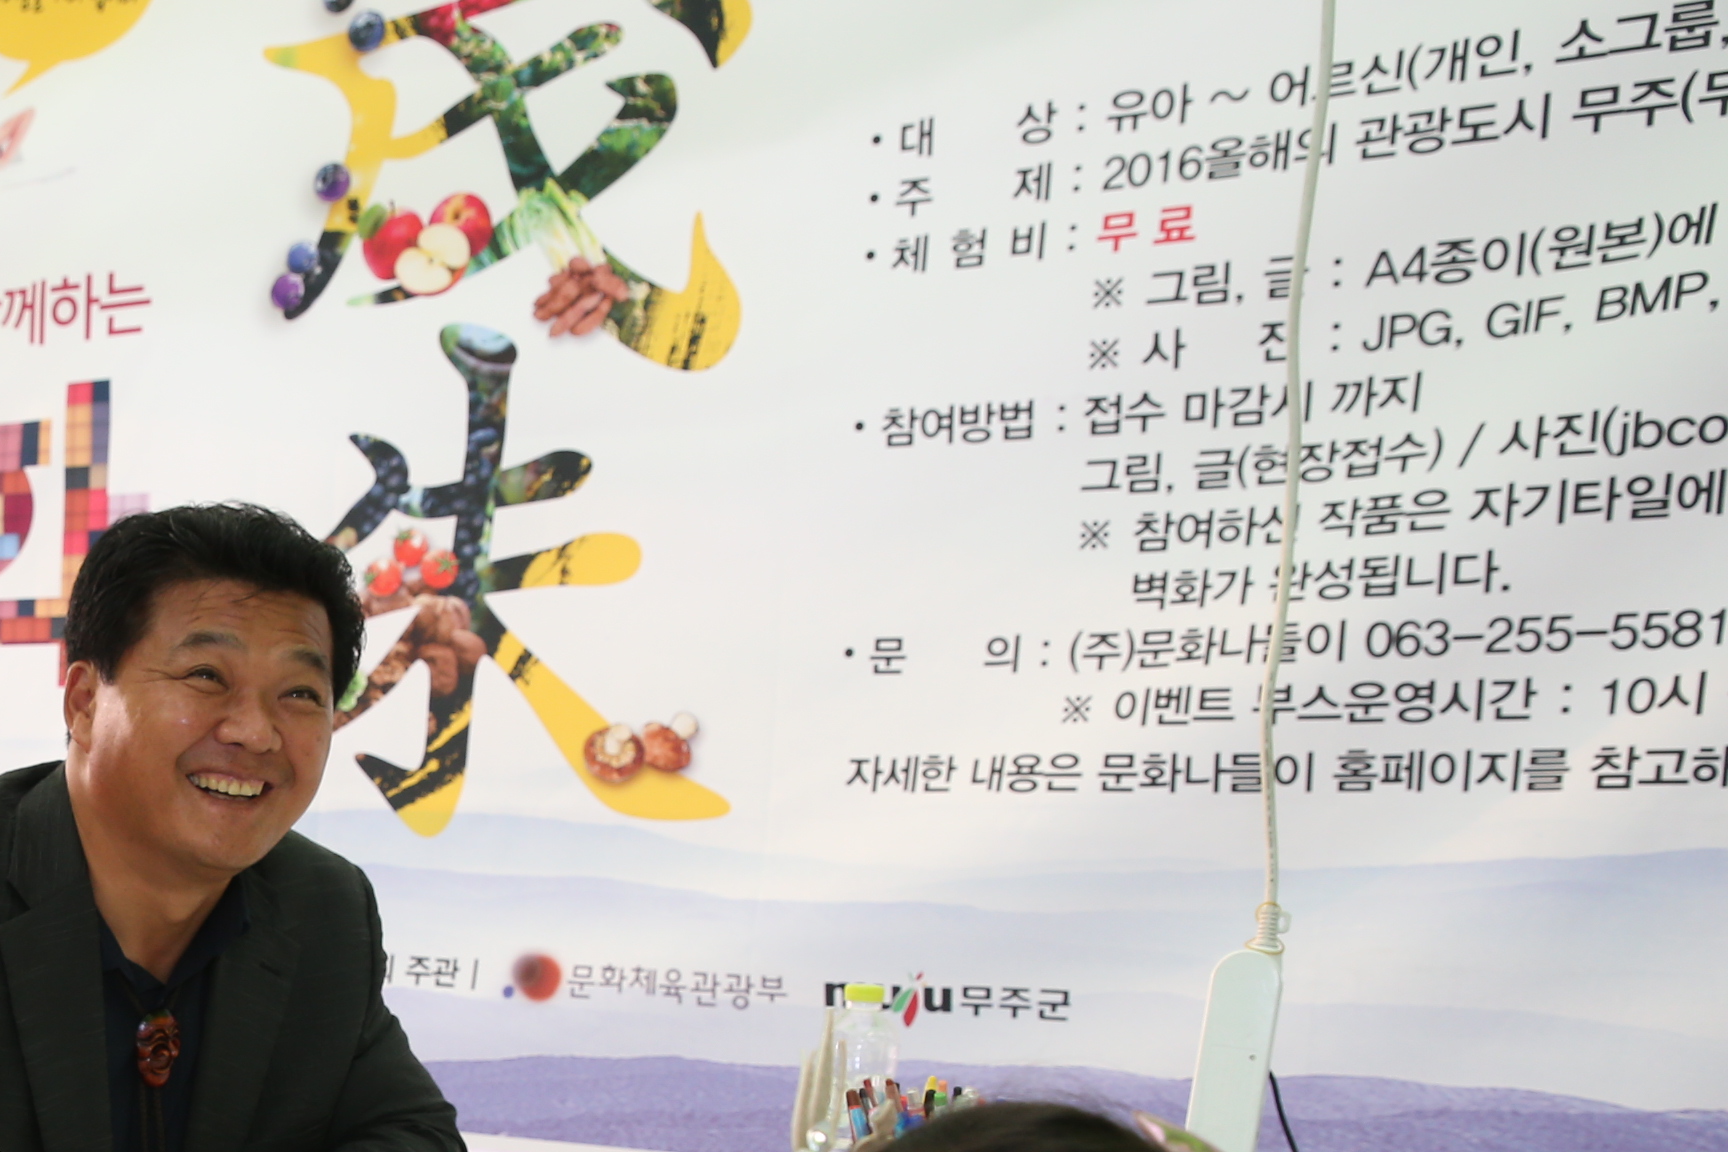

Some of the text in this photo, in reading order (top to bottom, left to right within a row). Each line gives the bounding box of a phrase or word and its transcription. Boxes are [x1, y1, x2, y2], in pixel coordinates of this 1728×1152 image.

[1106, 82, 1193, 136] 유아
[1356, 92, 1552, 161] 관광도시
[1146, 260, 1245, 306] 그림,
[1365, 202, 1718, 289] A4종이(원본)에
[1142, 327, 1186, 371] 사
[1363, 308, 1464, 352] JPG,
[1486, 295, 1573, 340] GIF,
[1595, 271, 1720, 324] BMP,
[881, 371, 1424, 447] 참여방법 접수 마감시 까지
[1080, 452, 1174, 494] 그림,
[1194, 428, 1444, 491] 글(현장접수)
[1320, 489, 1453, 538] 작품은
[1470, 468, 1728, 528] 자기타일에
[1132, 565, 1255, 611] 벽화가
[1366, 607, 1728, 659] 063-255-5581
[1114, 685, 1236, 727] 이벤트
[1603, 671, 1709, 718] 10시
[846, 755, 957, 793] 자세한
[970, 751, 1083, 794] 내용은
[1097, 750, 1314, 794] 문화나들이
[1333, 746, 1571, 794] 홈페이지를
[405, 954, 460, 989] 주관
[568, 963, 788, 1011] 문화체육관광부
[960, 985, 1072, 1021] 무주군
